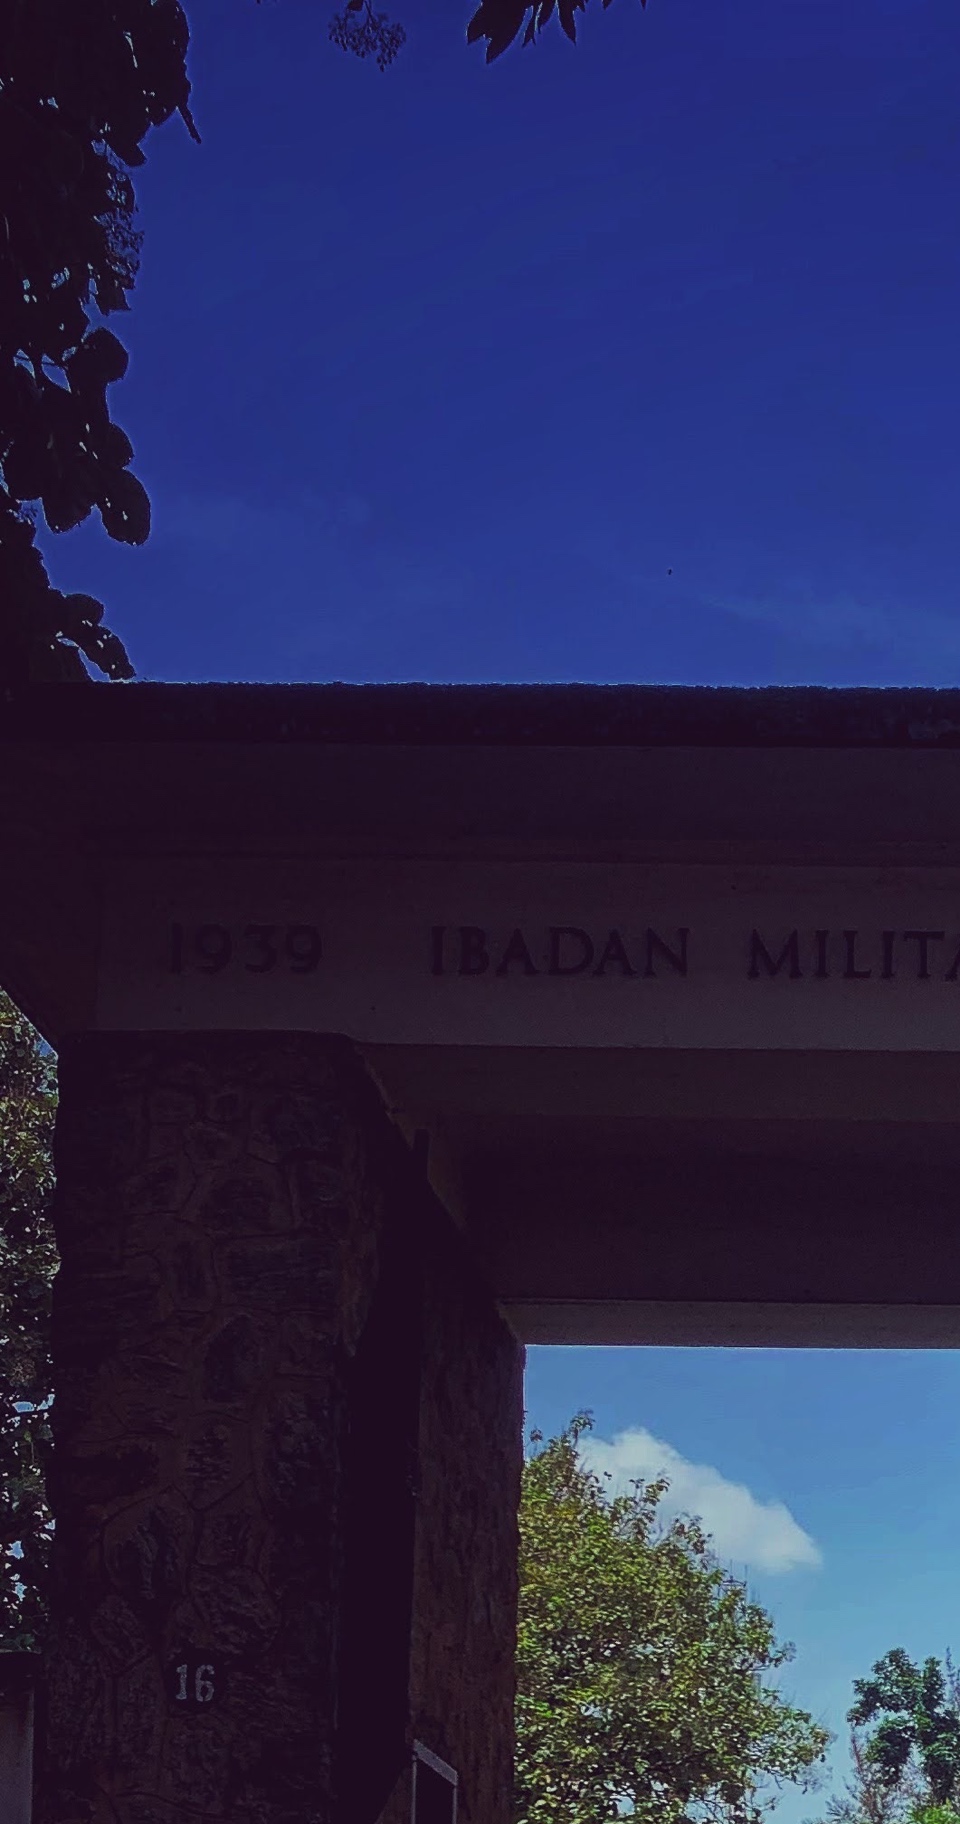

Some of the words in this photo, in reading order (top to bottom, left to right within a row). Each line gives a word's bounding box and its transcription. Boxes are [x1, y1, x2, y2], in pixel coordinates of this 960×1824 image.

[168, 922, 323, 976] 1939
[430, 926, 691, 978] IBADAN
[175, 1663, 215, 1702] 16
